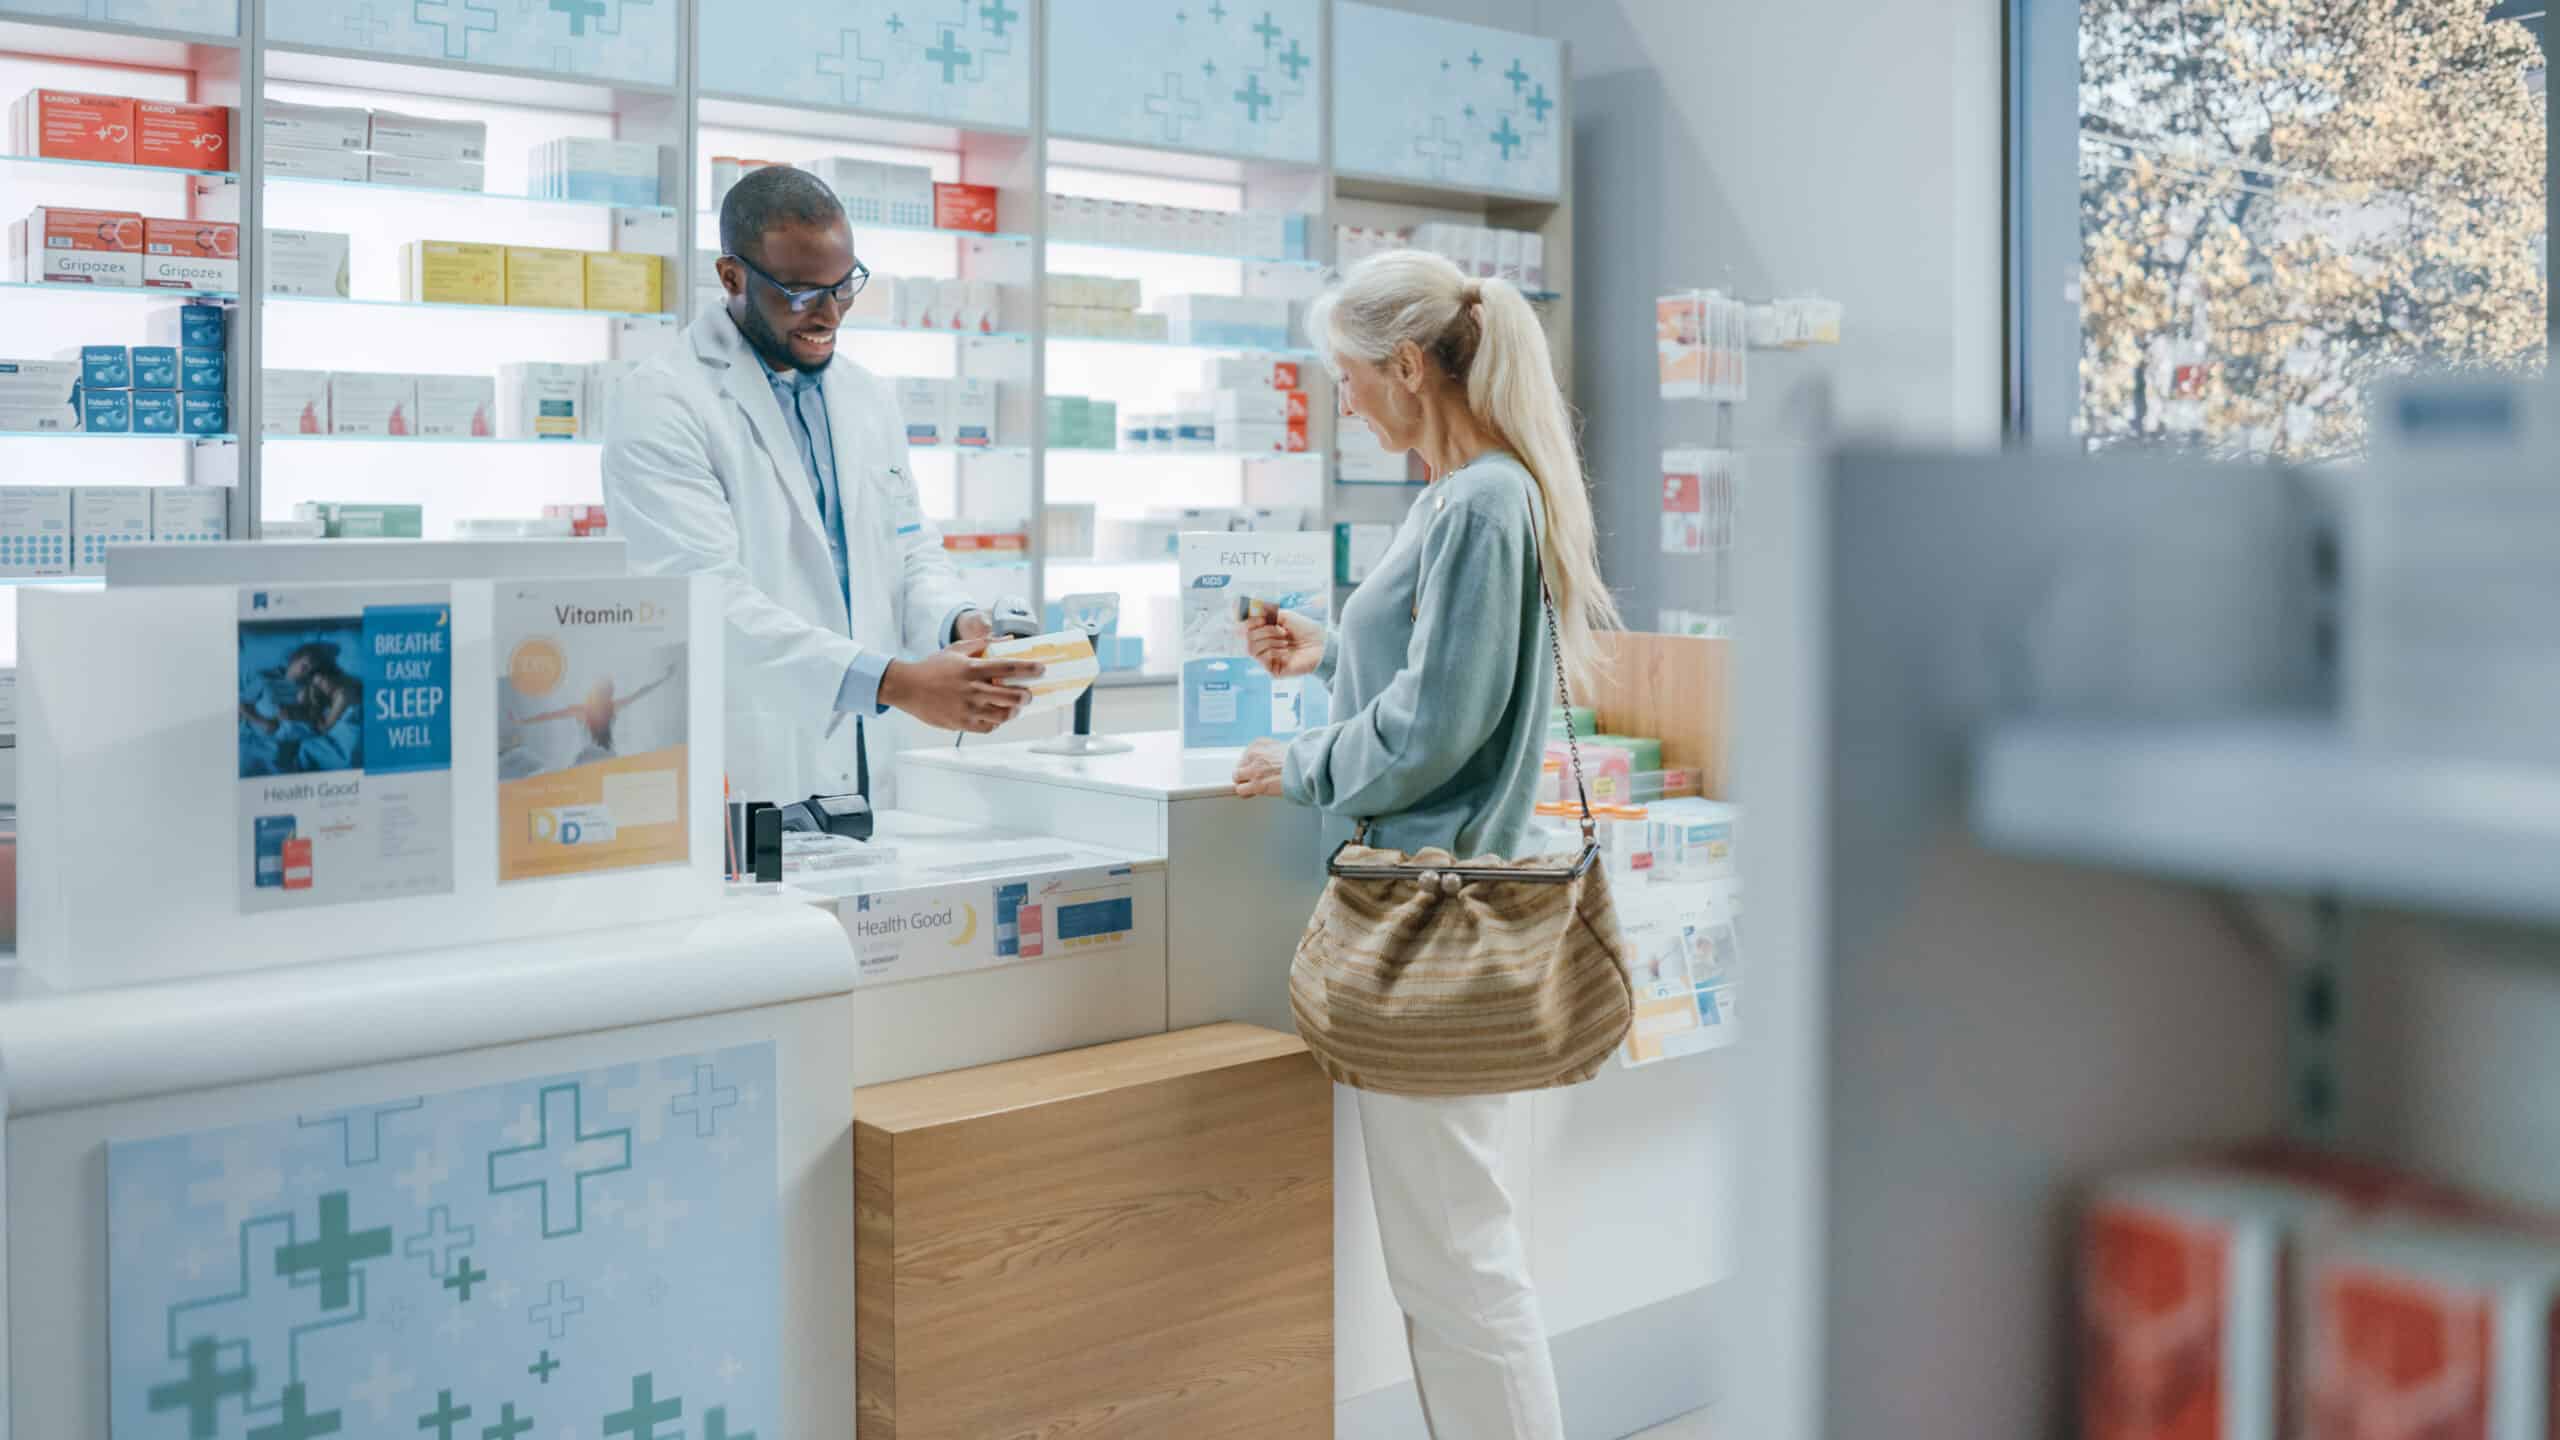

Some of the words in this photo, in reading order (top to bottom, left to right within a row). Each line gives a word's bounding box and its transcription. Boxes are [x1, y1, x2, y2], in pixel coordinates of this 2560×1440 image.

[58, 257, 126, 273] Gripozex
[159, 263, 222, 279] Gripozex
[1220, 551, 1271, 566] FATTY
[555, 602, 633, 625] Vitamin
[375, 632, 443, 655] BREATHE
[385, 661, 432, 680] EASILY
[375, 686, 443, 720] SLEEP
[388, 724, 432, 748] WELL
[263, 784, 314, 802] Health
[317, 780, 360, 798] Good
[857, 913, 907, 937] Health
[910, 906, 953, 930] Good
